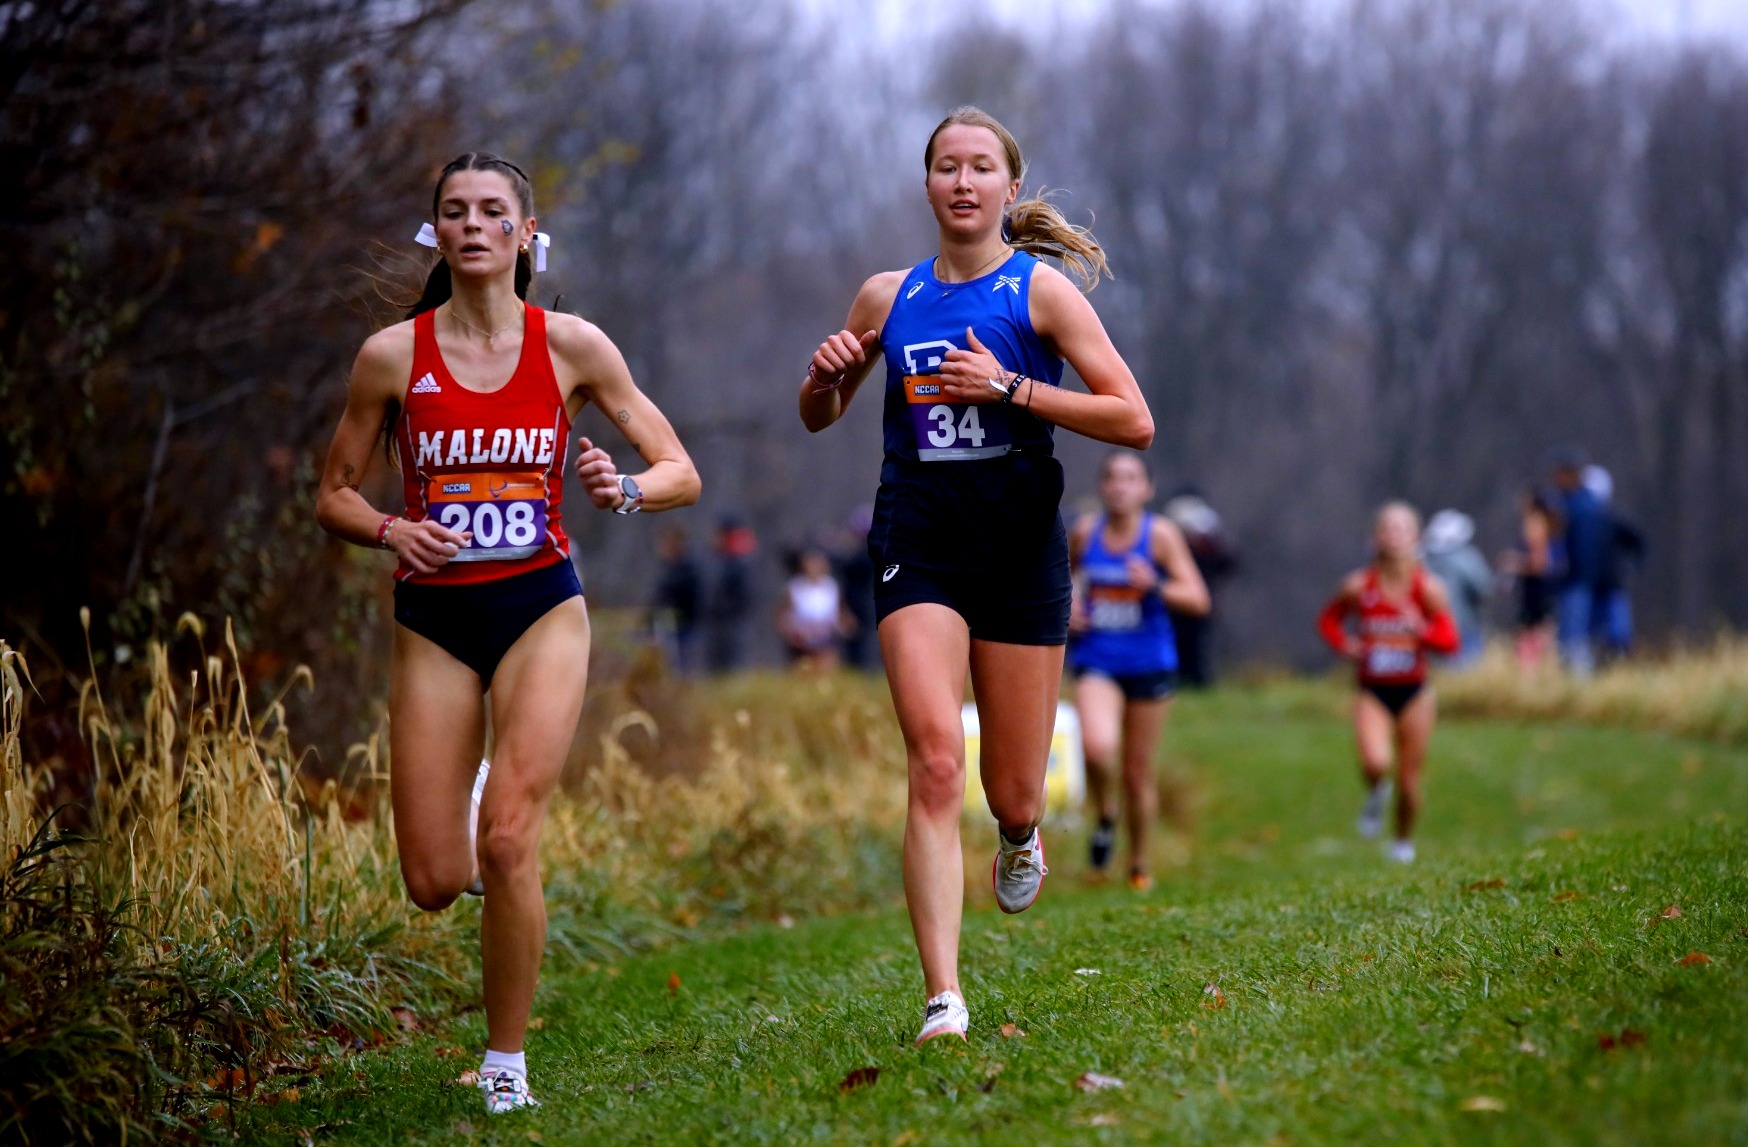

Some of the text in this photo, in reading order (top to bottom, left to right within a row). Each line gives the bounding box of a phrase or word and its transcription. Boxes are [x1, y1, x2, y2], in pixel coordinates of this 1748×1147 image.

[412, 385, 442, 393] adidas
[914, 385, 940, 394] NCCAA
[927, 404, 985, 447] 34
[418, 428, 554, 466] MALONE
[443, 484, 471, 494] NCCAA
[440, 502, 537, 547] 208
